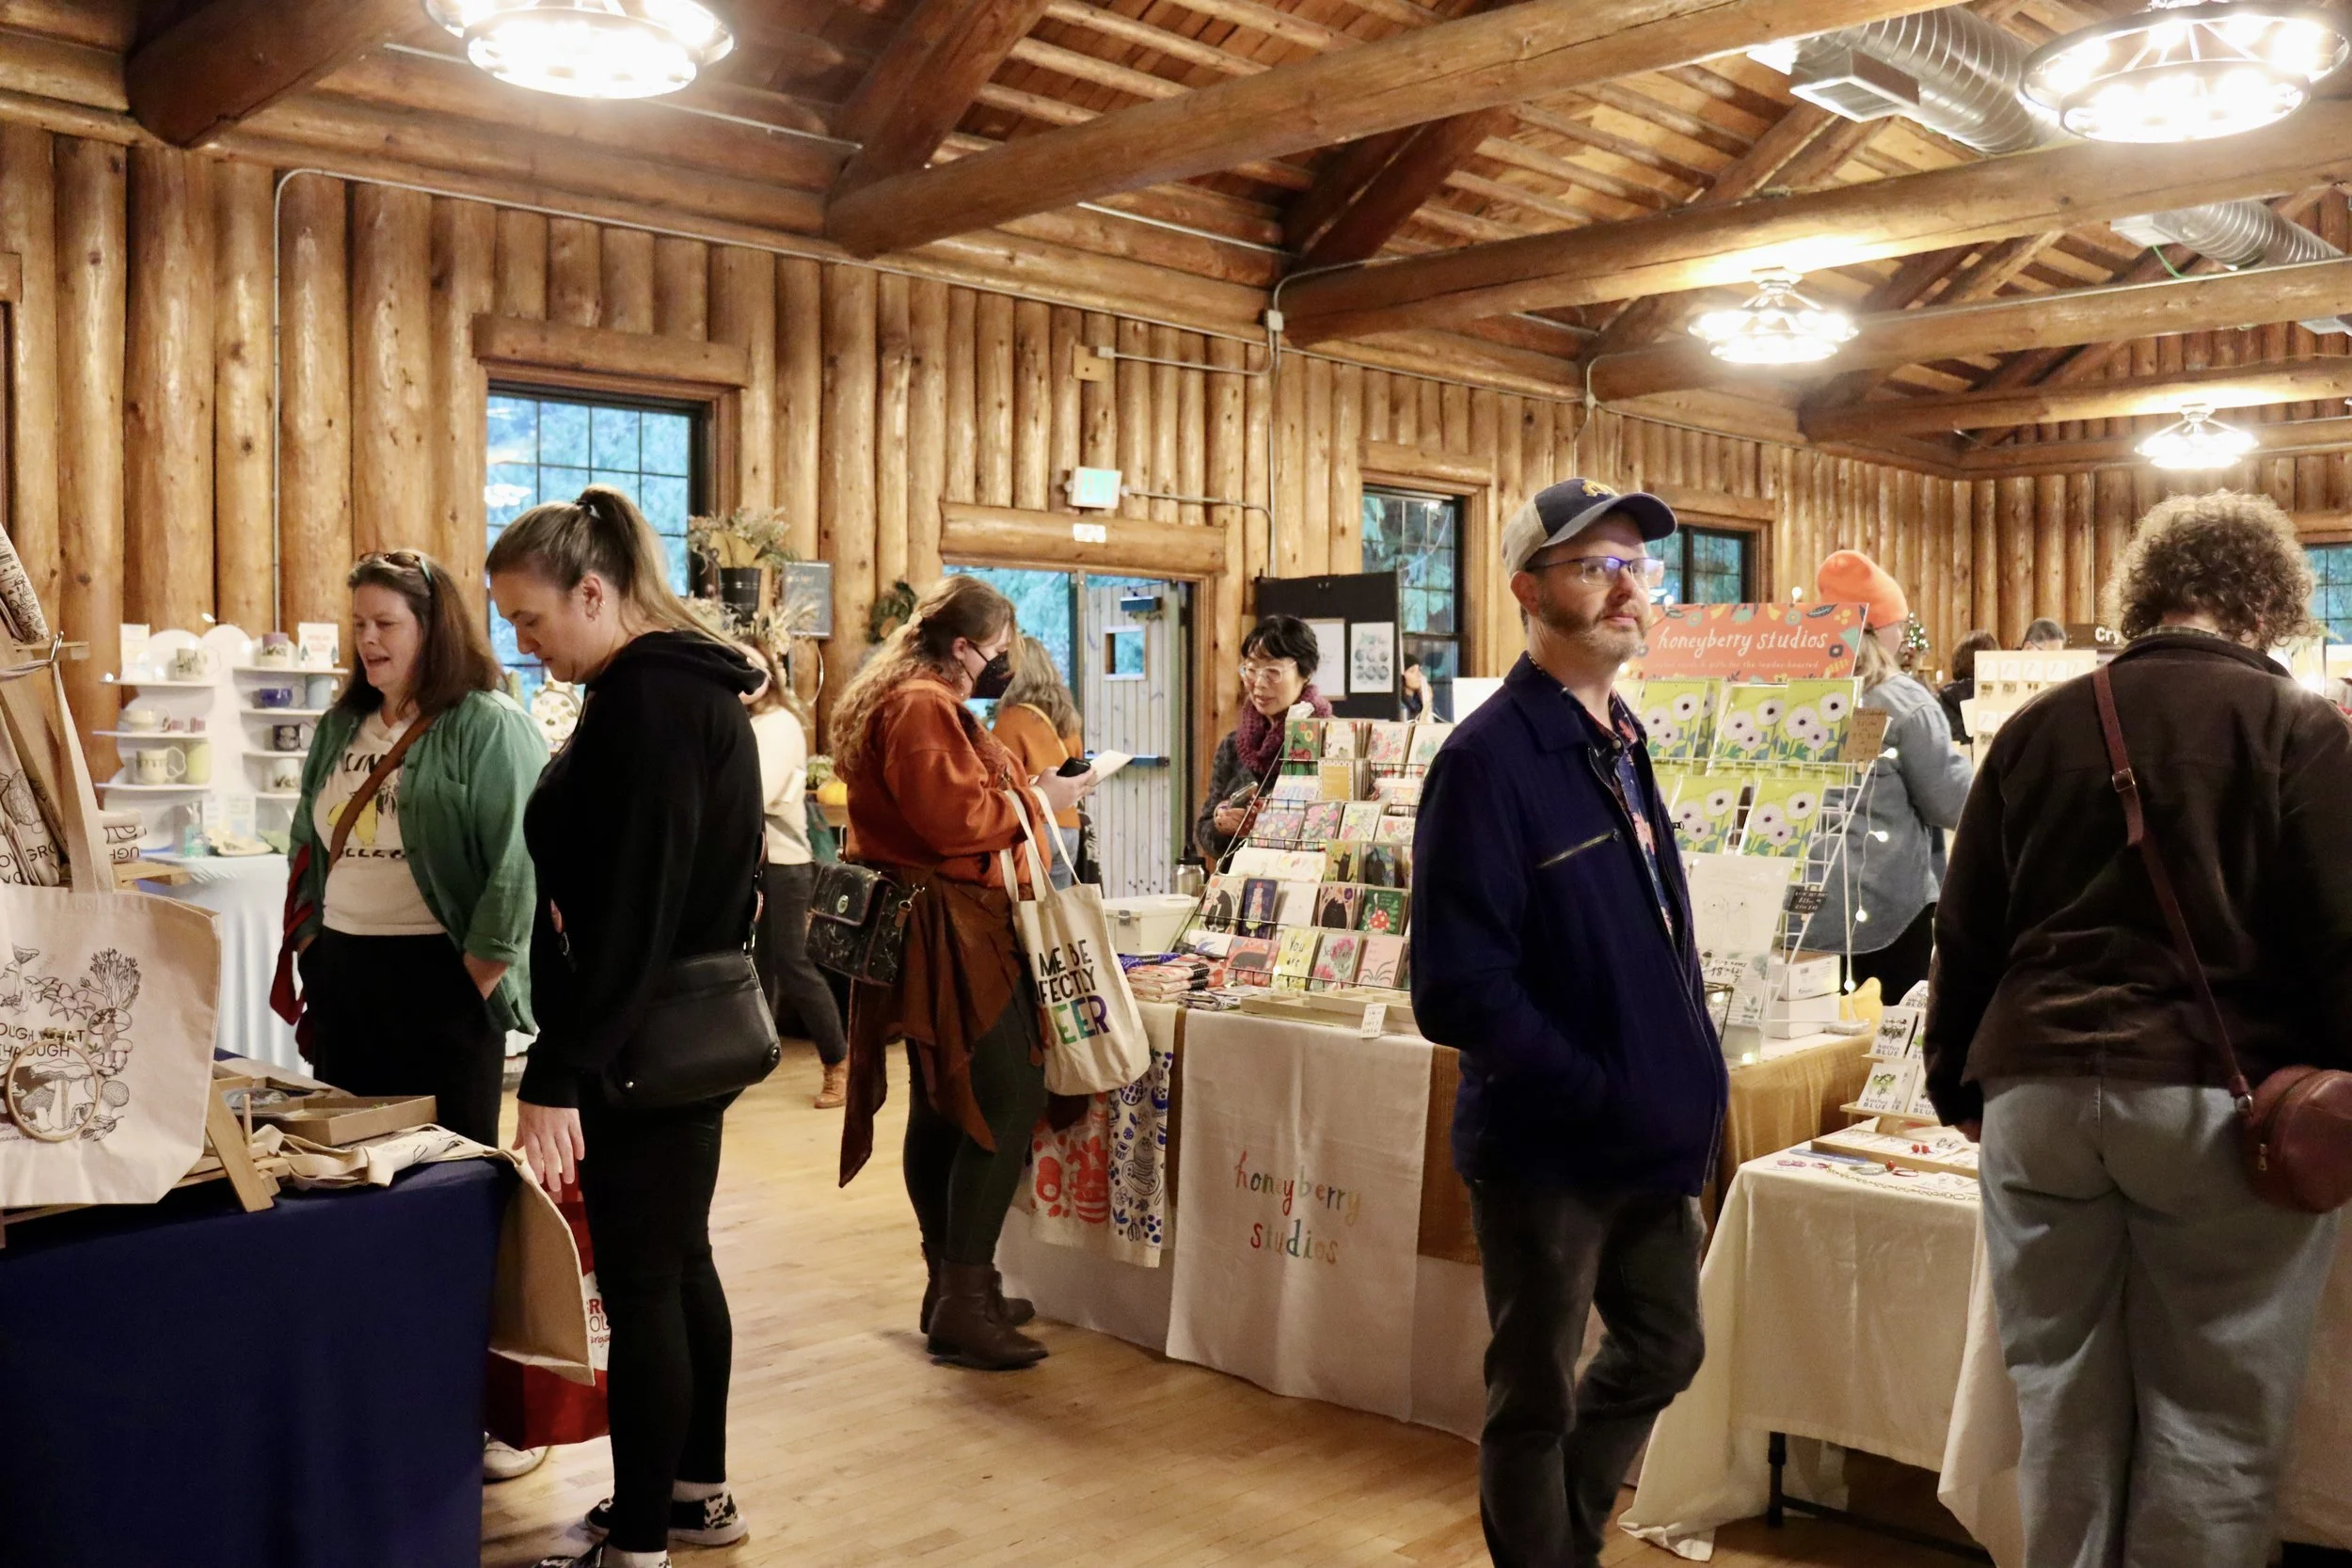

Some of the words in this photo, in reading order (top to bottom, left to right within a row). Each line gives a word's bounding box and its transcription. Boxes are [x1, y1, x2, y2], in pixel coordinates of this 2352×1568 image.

[1657, 626, 1753, 658] honeyberry
[1756, 625, 1828, 649] studios
[1289, 936, 1304, 953] You
[1039, 947, 1066, 976] ME
[1233, 1148, 1361, 1227] honeyberry
[1250, 1218, 1338, 1264] studios
